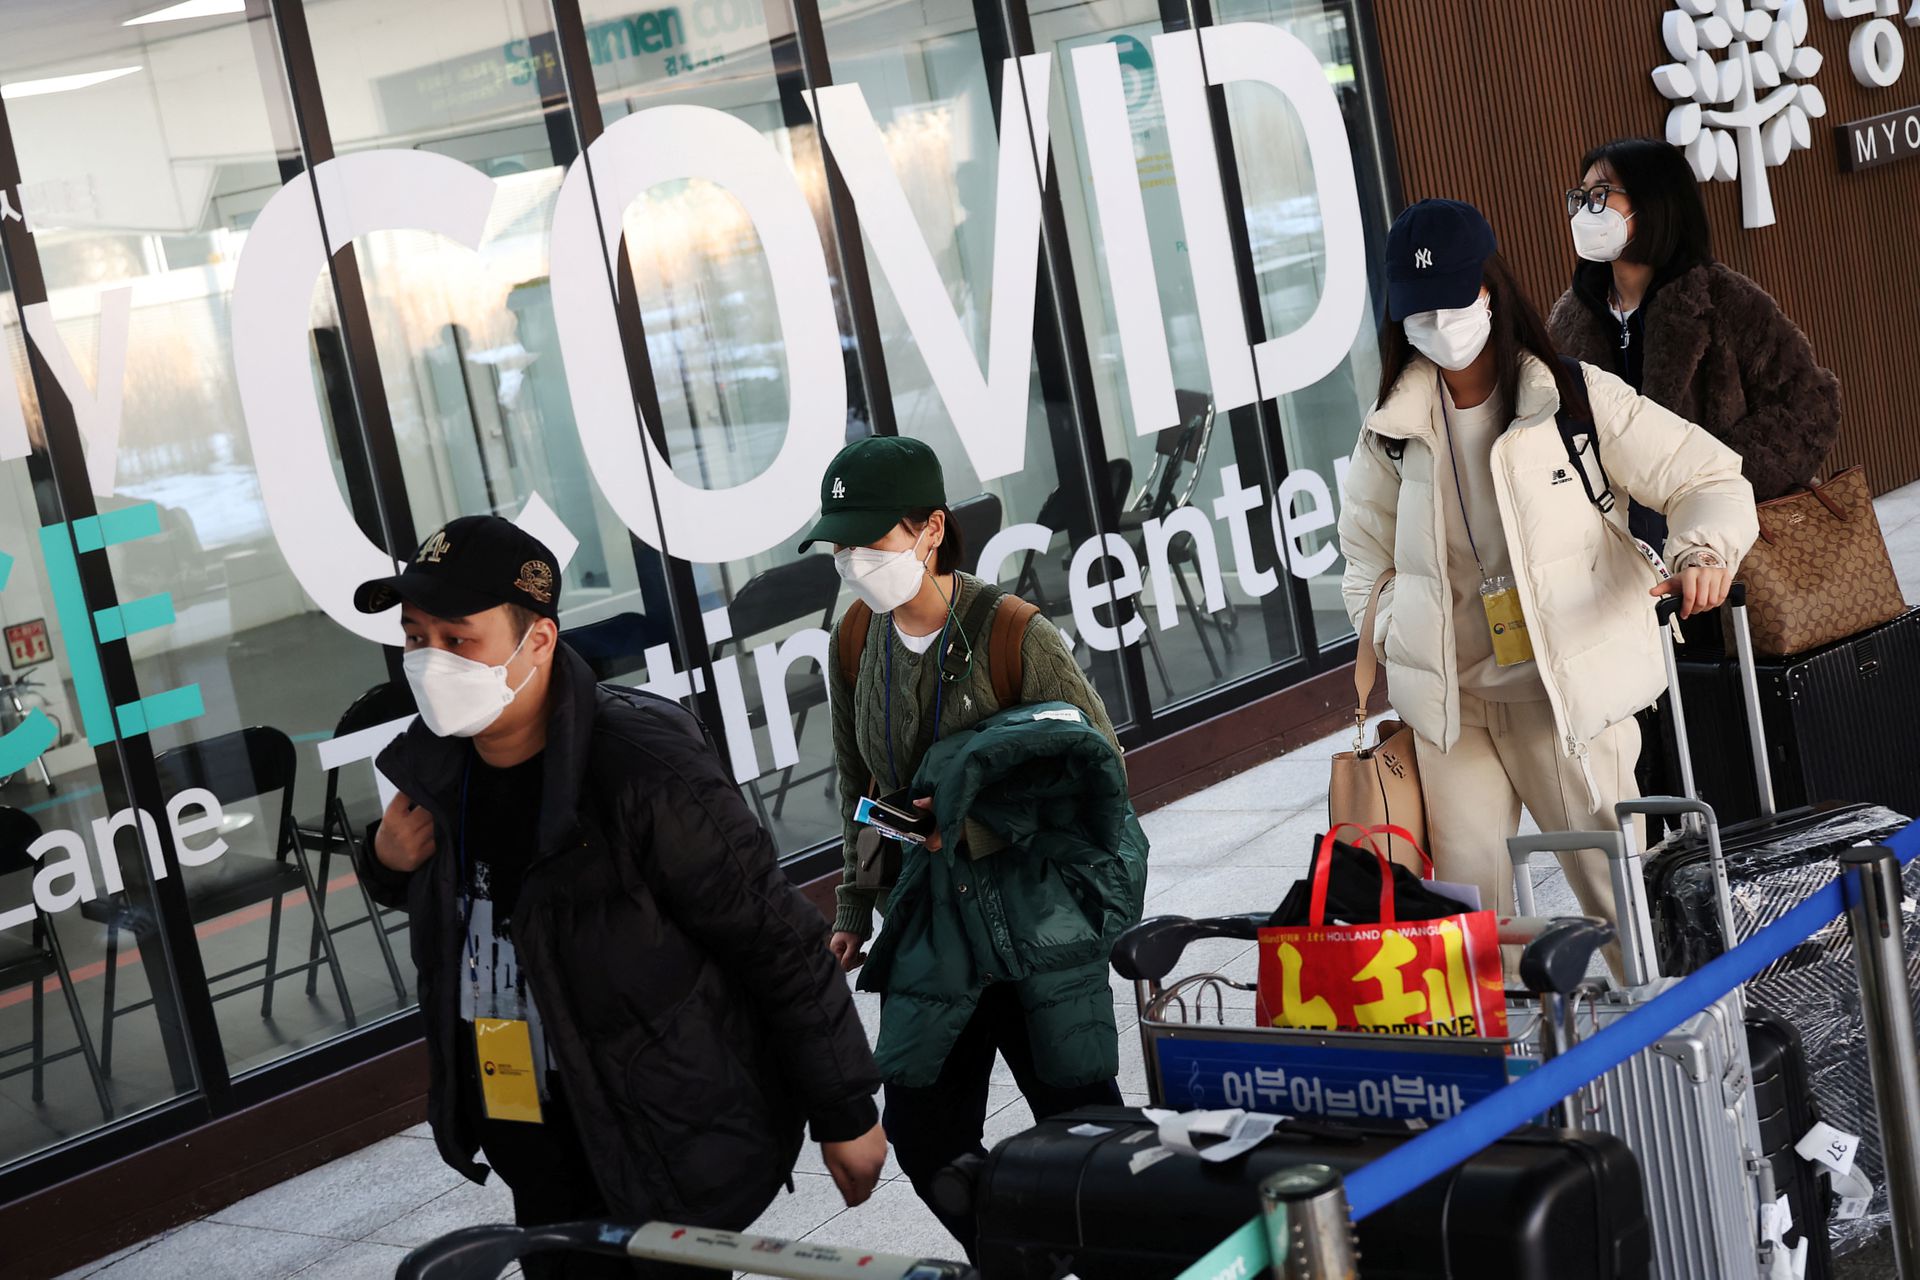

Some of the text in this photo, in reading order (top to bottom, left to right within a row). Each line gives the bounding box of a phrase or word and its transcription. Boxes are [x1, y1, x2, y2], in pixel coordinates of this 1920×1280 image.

[1414, 247, 1433, 269] NY
[232, 22, 1367, 646] COVID
[831, 477, 846, 499] LA
[975, 455, 1350, 652] Cente
[1827, 1140, 1848, 1162] 37
